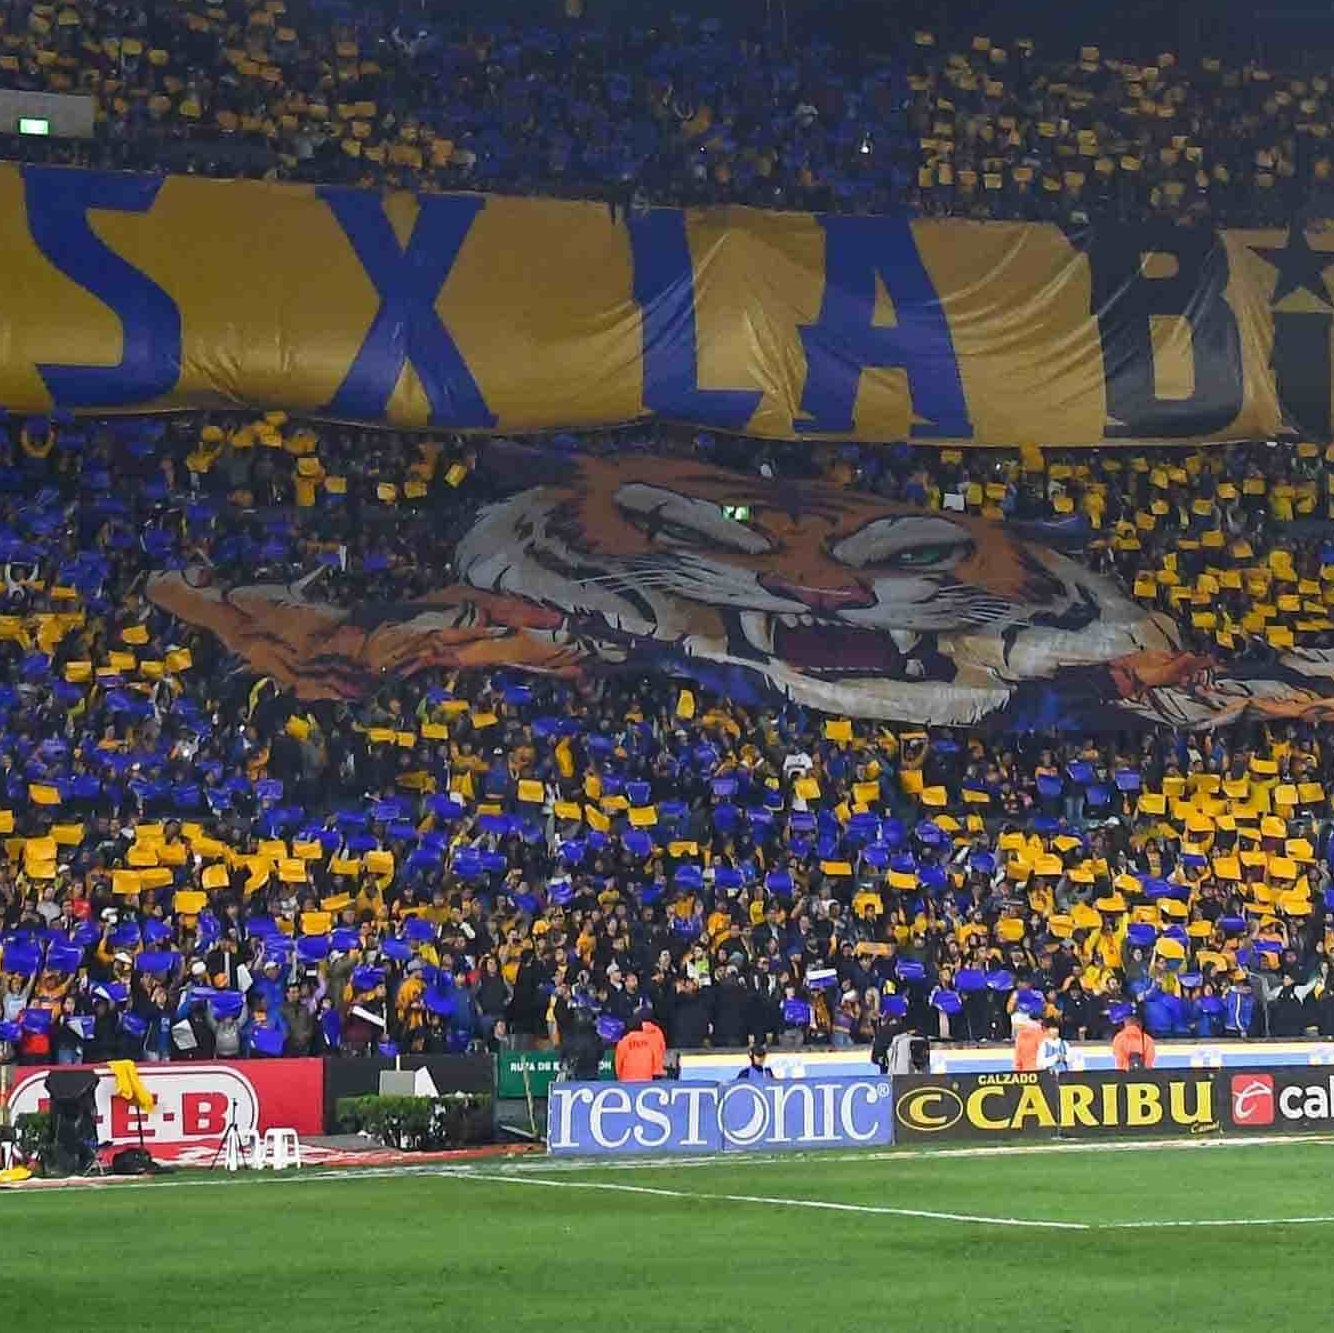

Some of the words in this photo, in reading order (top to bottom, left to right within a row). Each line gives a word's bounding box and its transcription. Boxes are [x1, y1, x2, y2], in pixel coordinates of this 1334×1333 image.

[316, 185, 498, 428] X
[628, 207, 973, 437] LA
[978, 1073, 1038, 1086] CALZADO
[38, 1092, 230, 1138] -E-B
[966, 1082, 1213, 1129] CARIBU
